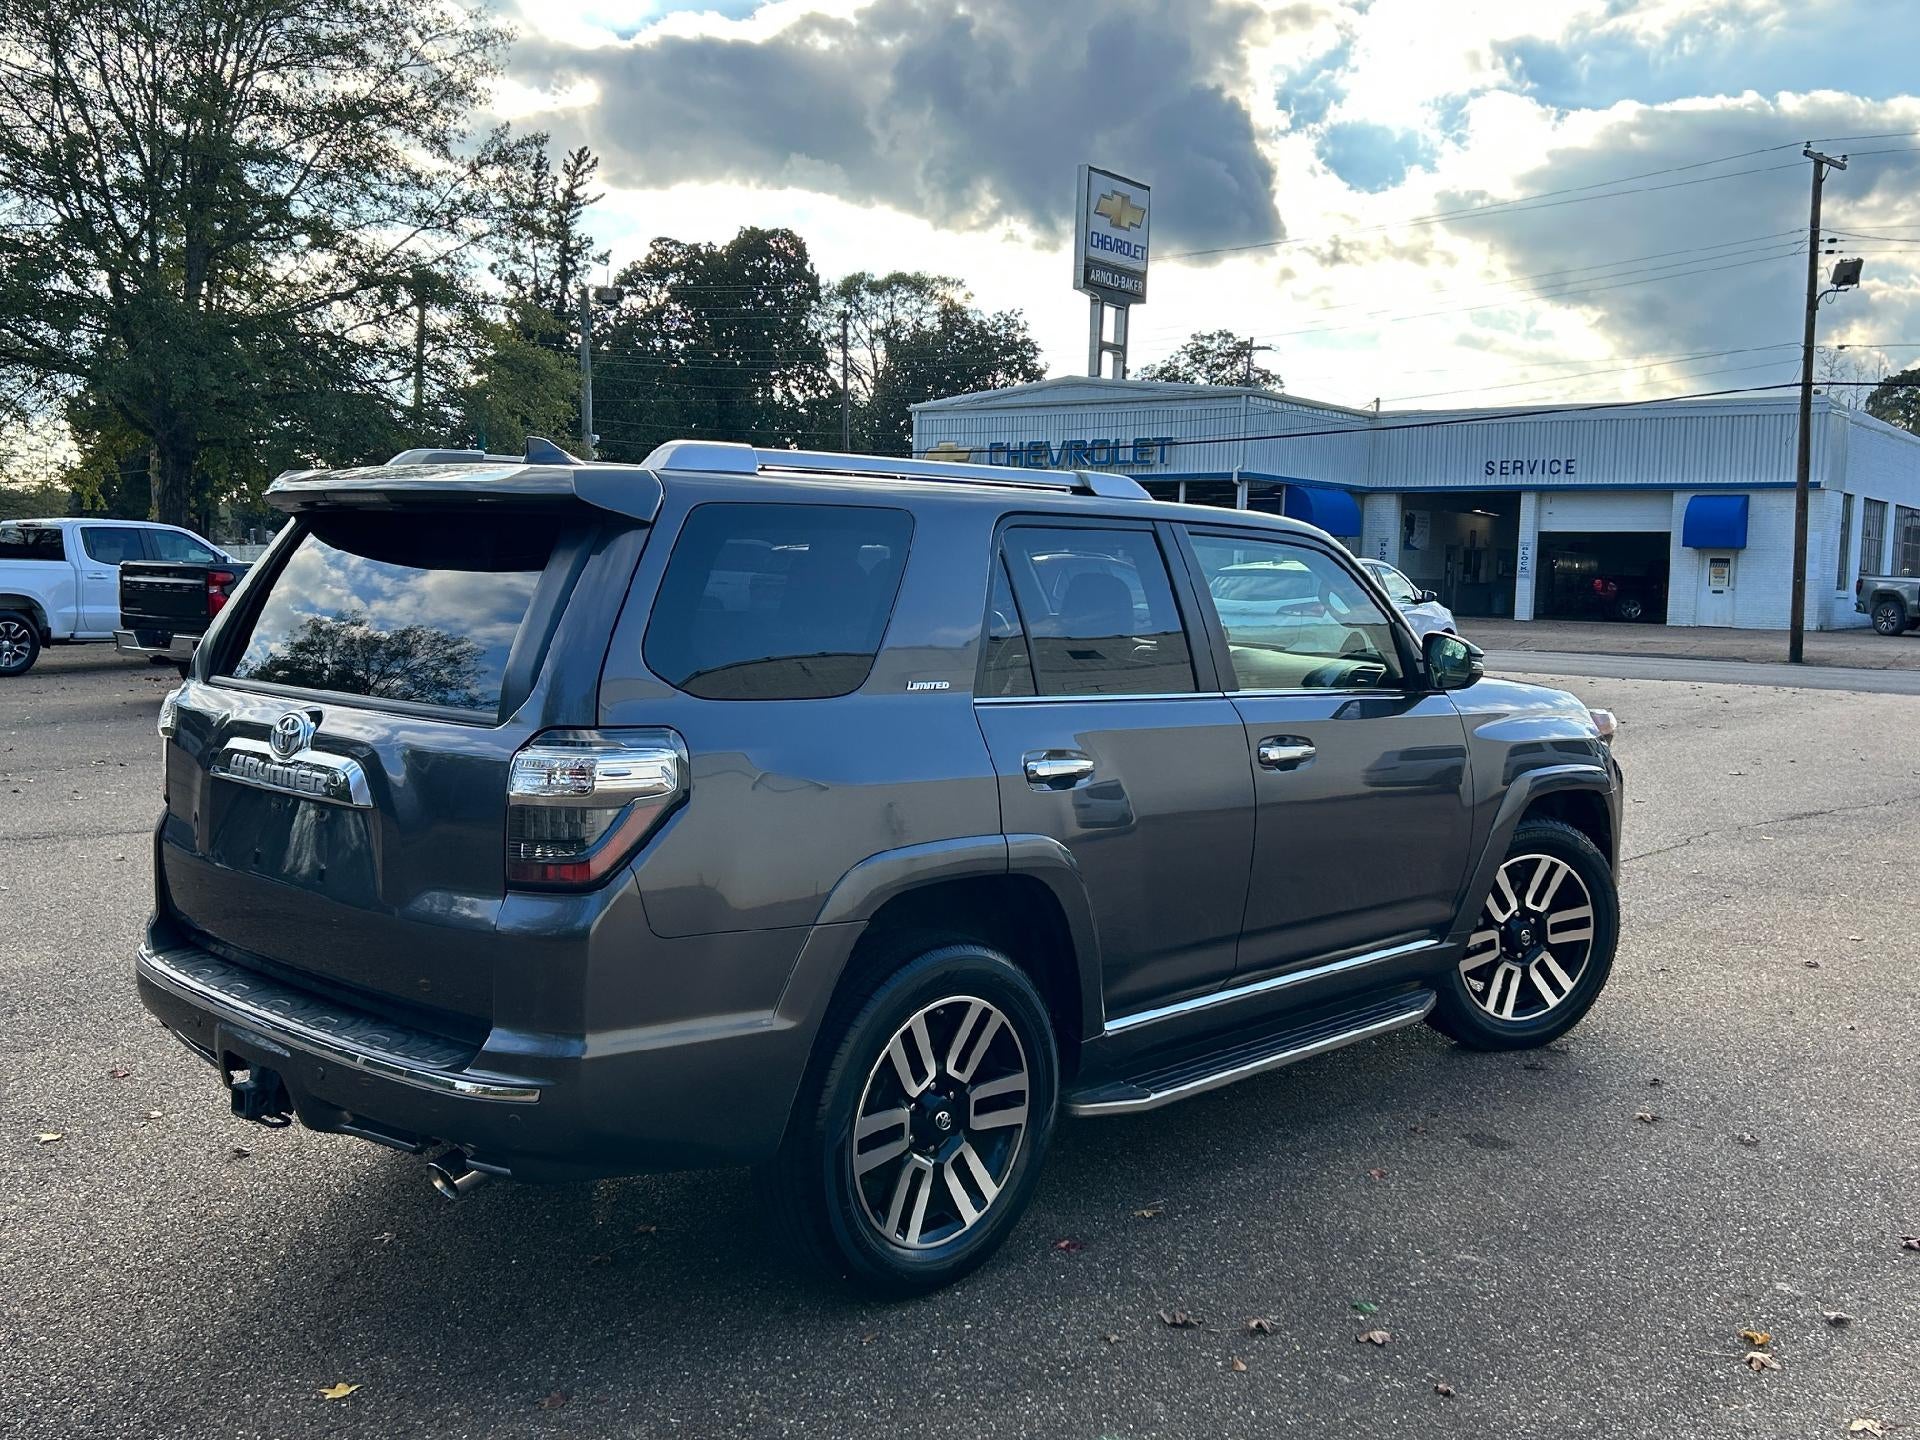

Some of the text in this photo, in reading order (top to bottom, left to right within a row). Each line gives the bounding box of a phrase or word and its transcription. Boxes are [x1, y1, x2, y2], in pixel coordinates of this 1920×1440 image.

[1090, 231, 1146, 260] CHEVROLET
[1090, 268, 1143, 293] ARNOLD-BAKER
[988, 436, 1174, 467] CHEVROLET
[1485, 459, 1576, 476] SERVICE
[1520, 546, 1529, 571] BLOCK
[229, 753, 328, 794] 4RUNNER
